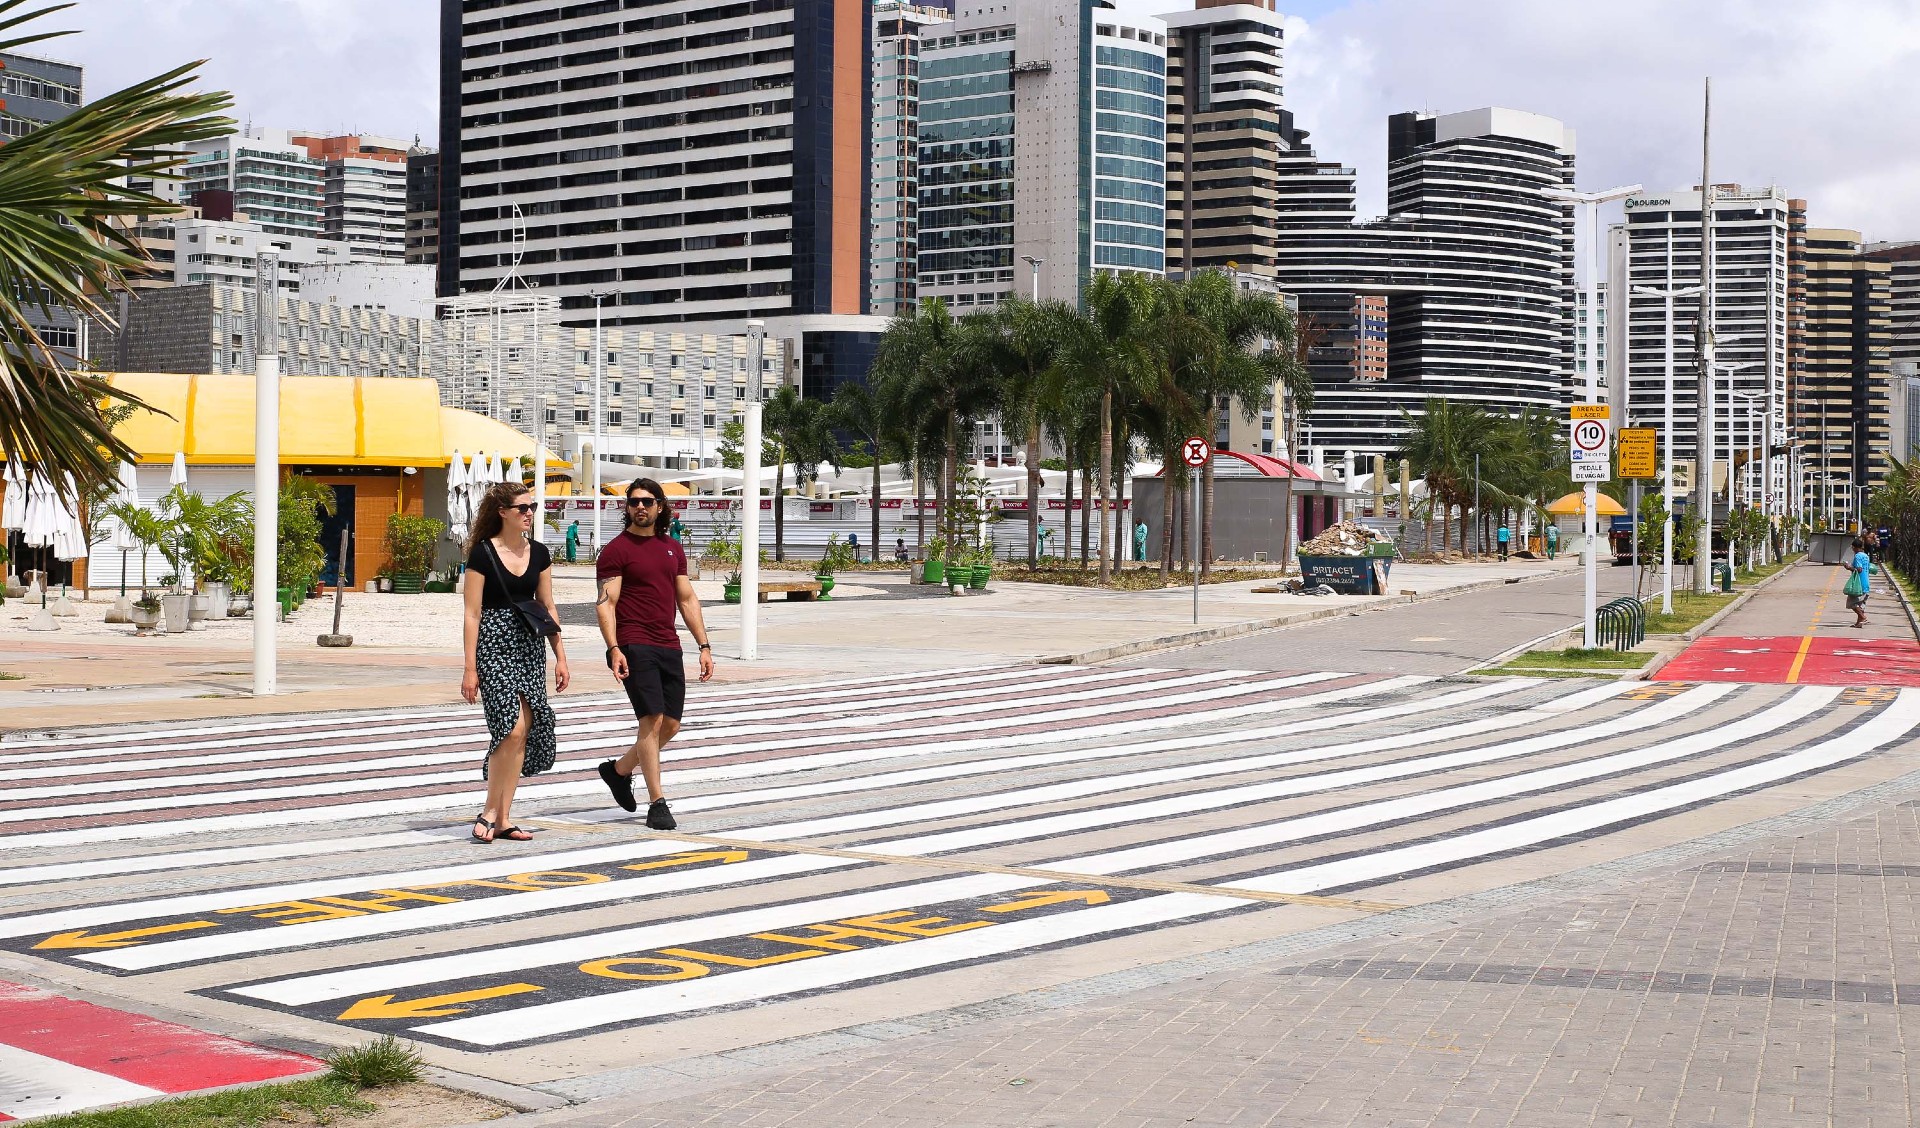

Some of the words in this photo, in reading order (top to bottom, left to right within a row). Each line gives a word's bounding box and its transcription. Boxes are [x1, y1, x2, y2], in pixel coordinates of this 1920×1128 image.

[1581, 427, 1599, 439] 10
[215, 871, 612, 925] OLHE
[577, 910, 1000, 981] OLHE
